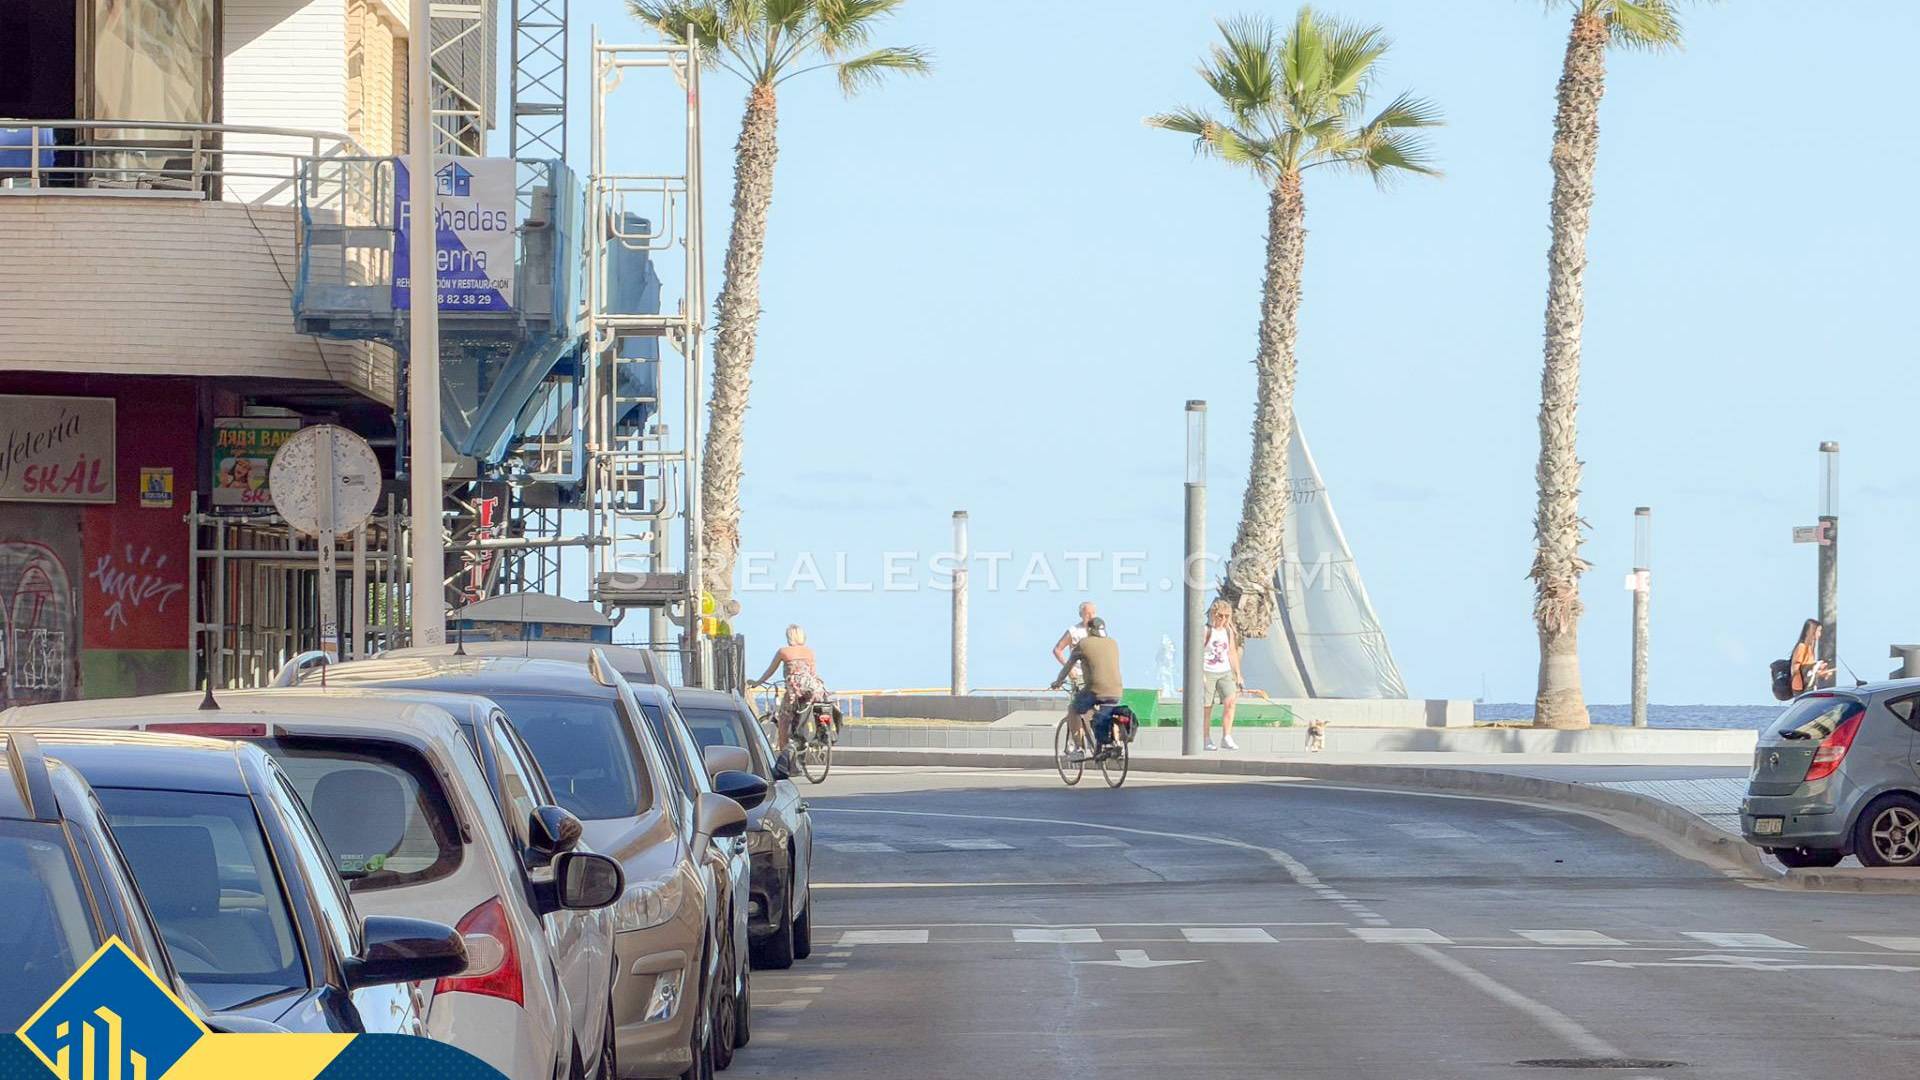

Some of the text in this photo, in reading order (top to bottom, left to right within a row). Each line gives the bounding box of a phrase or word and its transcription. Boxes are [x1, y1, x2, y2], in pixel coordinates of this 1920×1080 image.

[400, 201, 507, 231] Fhadas
[436, 249, 487, 271] erna
[447, 295, 460, 304] 82
[462, 295, 476, 304] 38
[478, 295, 492, 305] 29
